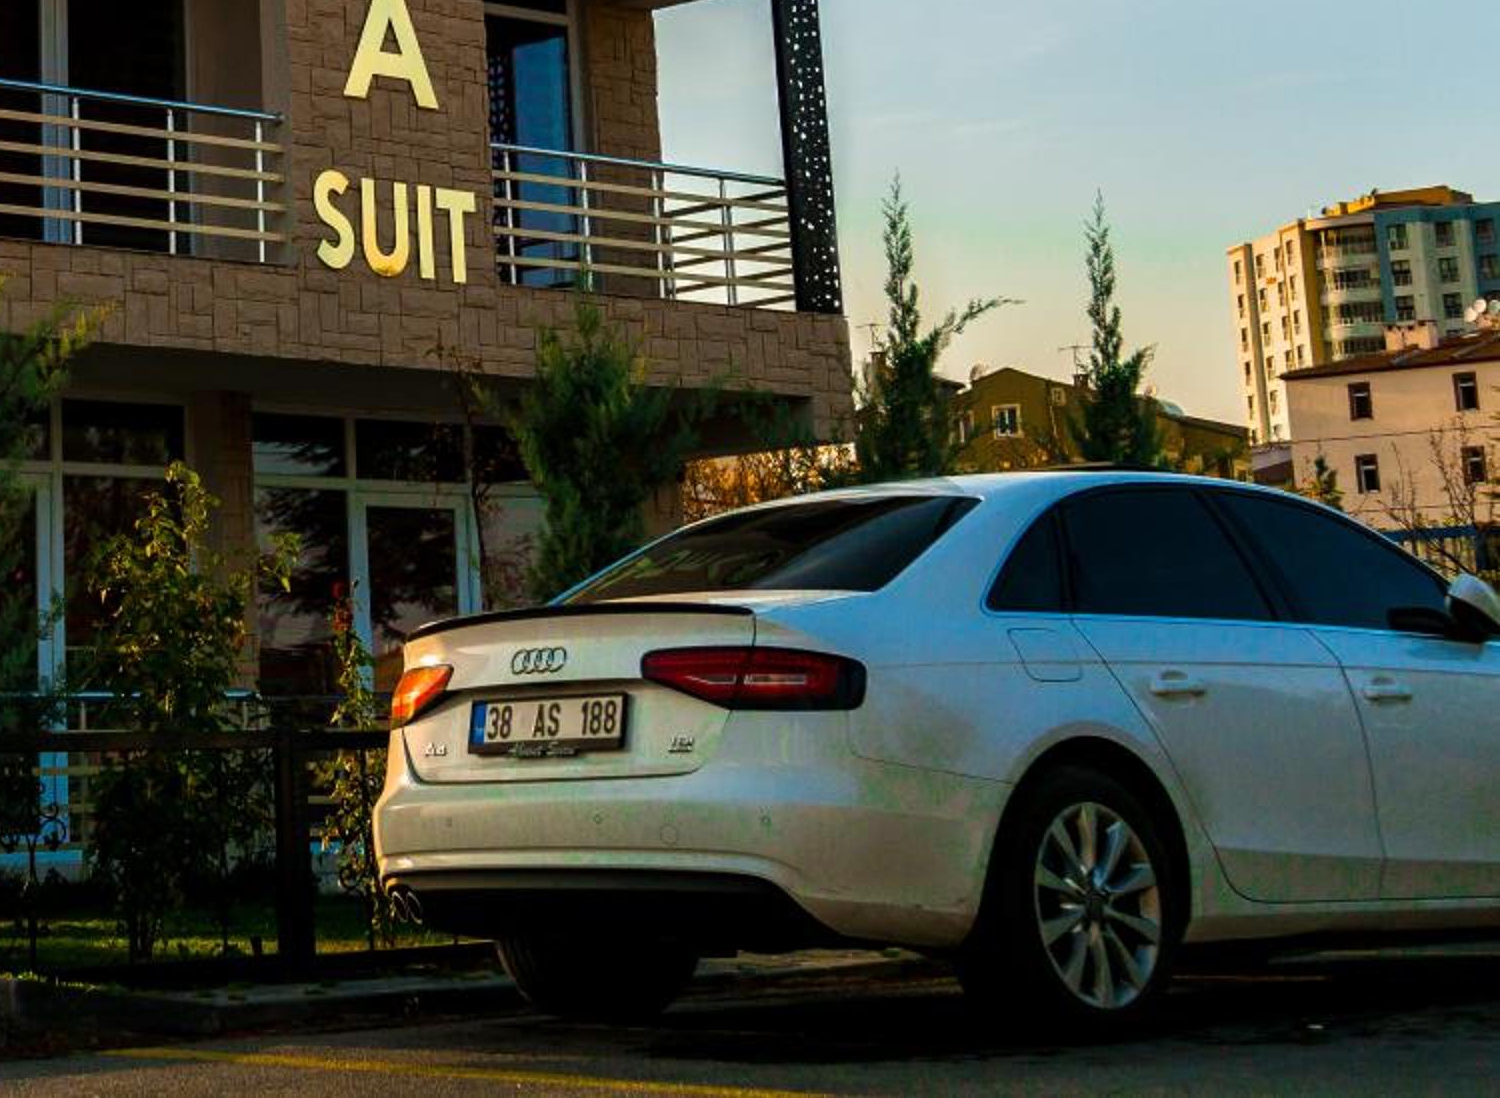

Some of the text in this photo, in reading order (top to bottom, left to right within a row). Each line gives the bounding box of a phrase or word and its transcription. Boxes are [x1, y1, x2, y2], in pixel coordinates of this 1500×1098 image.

[313, 169, 476, 285] SUIT
[487, 700, 617, 740] 38 AS 188
